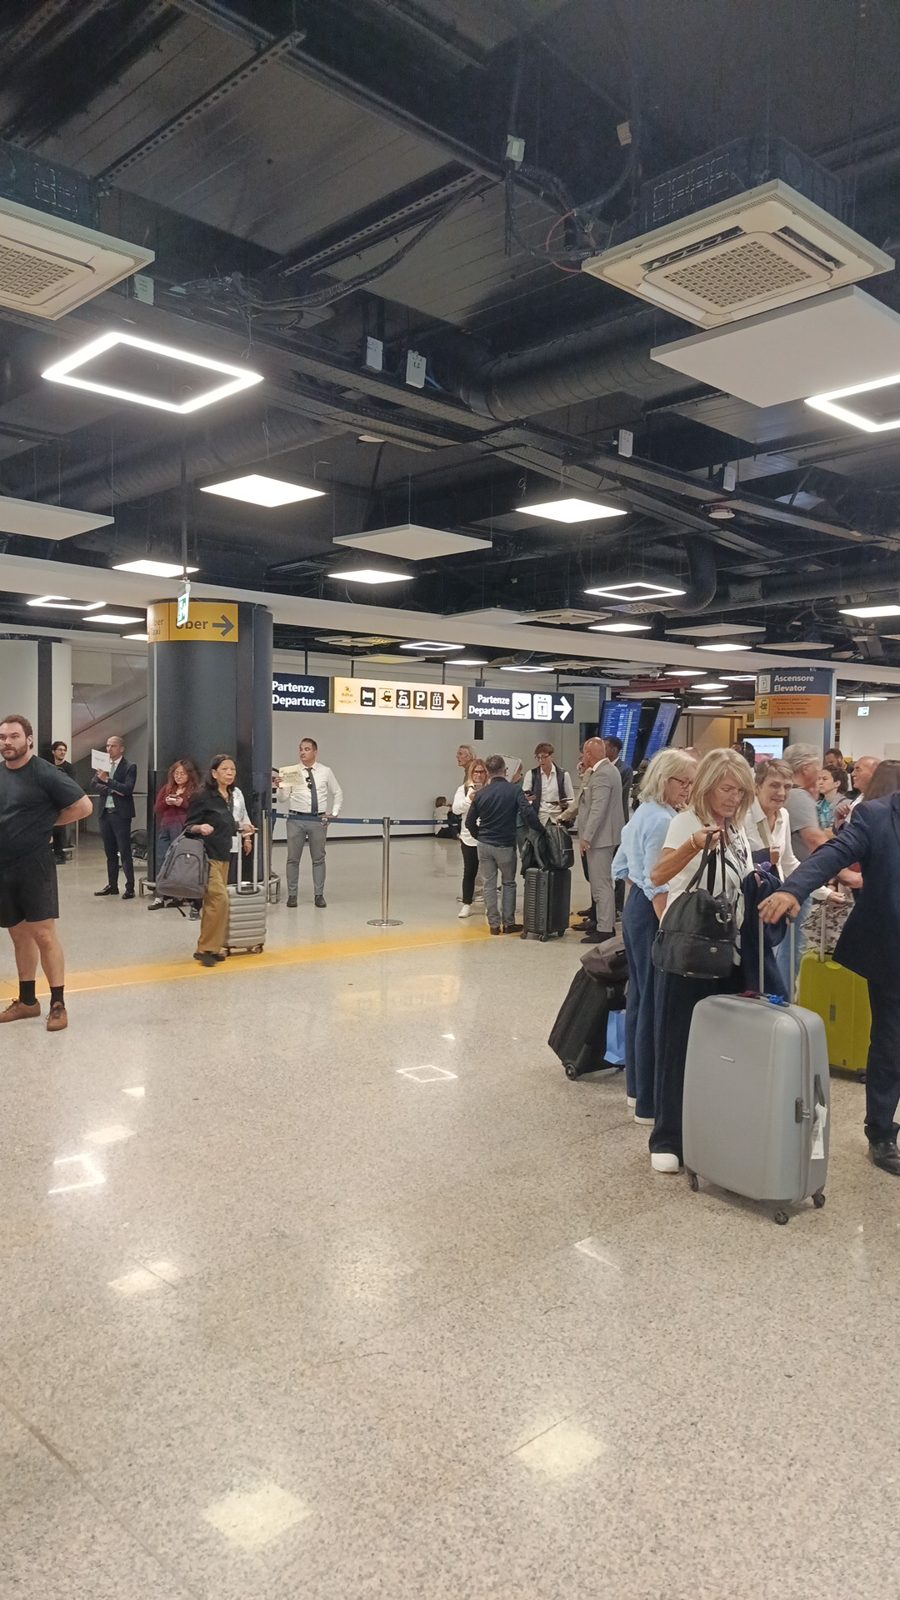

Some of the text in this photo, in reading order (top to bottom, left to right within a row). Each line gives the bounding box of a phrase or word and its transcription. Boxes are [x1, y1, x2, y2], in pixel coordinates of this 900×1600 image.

[272, 680, 315, 693] Partenze
[774, 684, 807, 692] Elevator
[272, 694, 326, 708] Departures
[477, 694, 510, 704] Partenze
[468, 705, 510, 717] Departures
